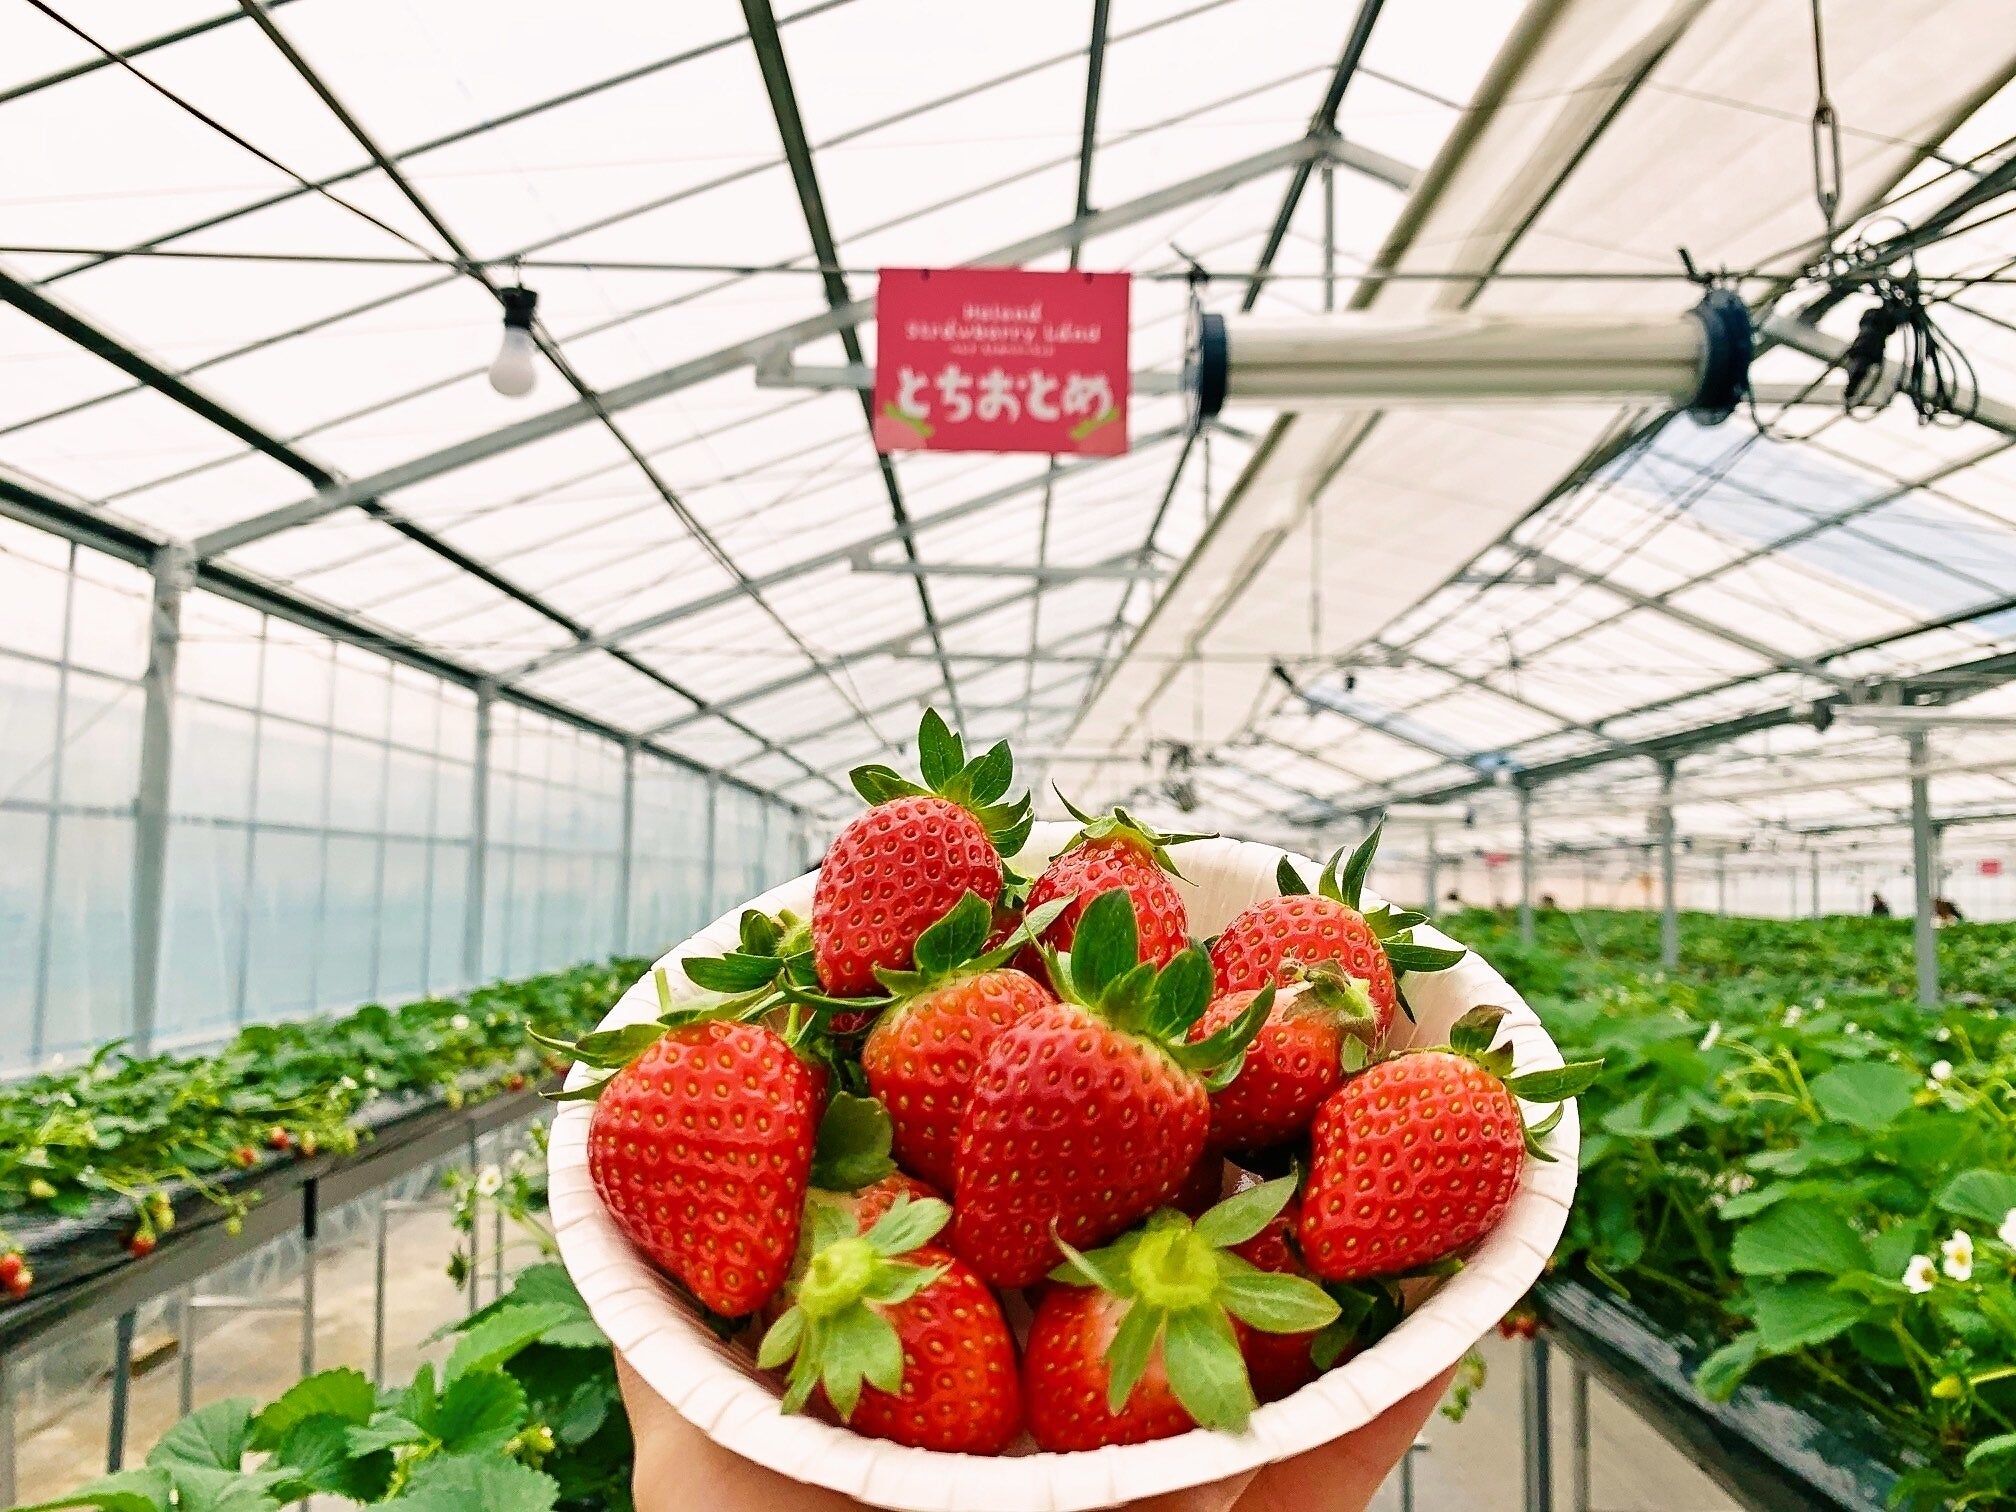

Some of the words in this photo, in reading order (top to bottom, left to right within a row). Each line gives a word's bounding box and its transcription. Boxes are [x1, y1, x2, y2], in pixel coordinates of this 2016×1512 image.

[898, 363, 1114, 424] とちおとめ
